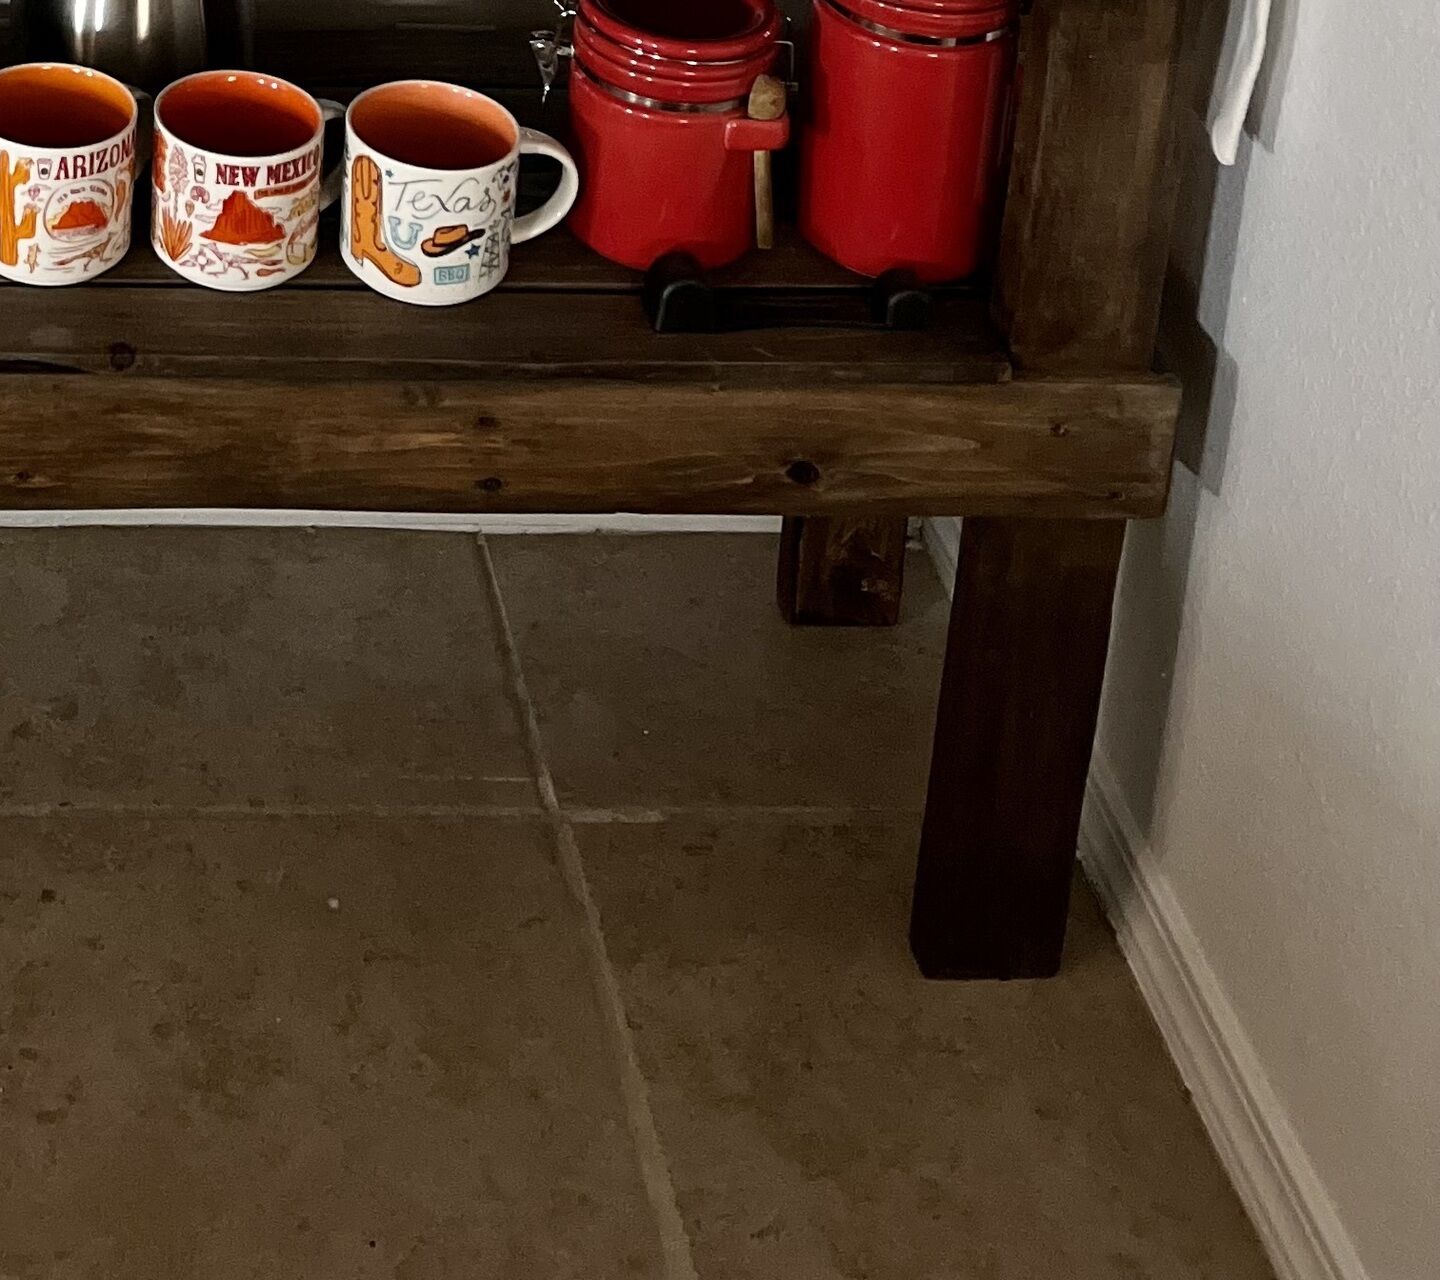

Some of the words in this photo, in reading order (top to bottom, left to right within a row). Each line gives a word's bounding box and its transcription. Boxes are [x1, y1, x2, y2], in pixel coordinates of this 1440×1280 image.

[215, 163, 261, 187] NEW
[266, 144, 320, 185] MEXICO
[388, 177, 497, 226] Texas
[438, 268, 465, 281] BBQ
